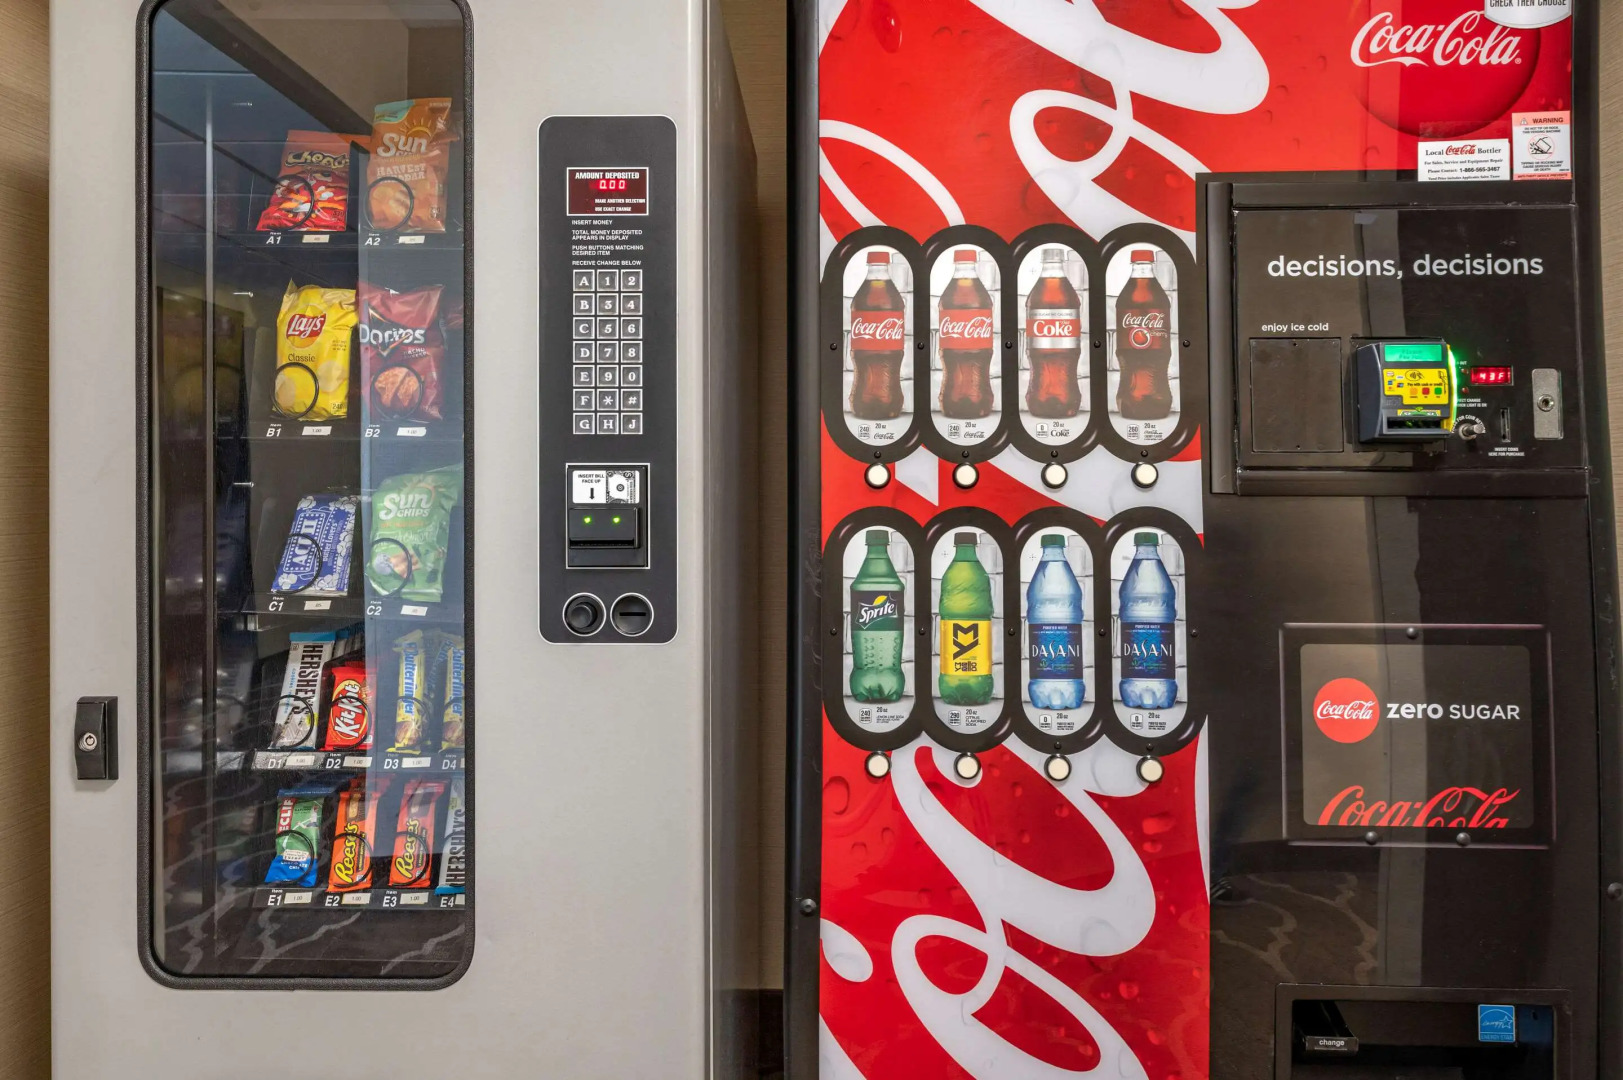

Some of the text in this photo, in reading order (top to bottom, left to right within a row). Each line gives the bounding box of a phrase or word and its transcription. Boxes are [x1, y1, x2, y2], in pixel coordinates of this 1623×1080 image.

[1351, 10, 1521, 67] Coca-Cola
[377, 133, 427, 157] Sun
[1445, 144, 1476, 156] Coca-Cola
[377, 163, 426, 177] HARVEST
[599, 180, 626, 189] 0.00
[266, 236, 281, 244] A1
[365, 237, 381, 246] A2
[1267, 253, 1544, 280] decisions, decisions
[579, 277, 589, 286] A
[605, 277, 610, 286] 1
[628, 277, 636, 286] 2
[580, 300, 589, 310] B
[604, 300, 612, 310] 3
[627, 300, 635, 310] 4
[288, 314, 326, 338] Lay's
[1122, 313, 1165, 329] Coca-Cola
[579, 324, 589, 333] C
[604, 324, 612, 333] 5
[628, 324, 636, 333] 6
[852, 317, 904, 340] Coca-Cola
[939, 316, 992, 339] Coca-Cola
[1033, 320, 1073, 337] Coke
[1261, 322, 1329, 333] enjoy ice cold
[360, 324, 426, 345] Doritos
[288, 353, 316, 362] Classic
[580, 348, 590, 358] D
[604, 348, 612, 358] 7
[628, 348, 636, 358] 8
[580, 372, 589, 381] E
[604, 372, 612, 381] 9
[628, 372, 636, 381] 0
[580, 396, 590, 405] F
[579, 420, 590, 429] G
[603, 420, 613, 429] H
[628, 420, 636, 429] J
[266, 428, 281, 437] B1
[365, 429, 381, 438] B2
[1050, 429, 1070, 437] Coke
[379, 493, 431, 520] Sun
[397, 508, 430, 517] CHIPS
[268, 601, 284, 611] C1
[366, 605, 382, 616] C2
[858, 603, 895, 623] Sprite
[1032, 641, 1080, 659] DASANI
[1124, 639, 1172, 659] DASANI
[403, 641, 418, 716] Butterfiner
[1317, 700, 1520, 720] Coca-Cola zero SUGAR
[268, 759, 282, 769] D1
[326, 759, 341, 769] D2
[384, 759, 399, 769] D3
[442, 759, 457, 770] D4
[335, 822, 359, 883] Rees's
[267, 894, 282, 906] E1
[325, 896, 340, 907] E2
[382, 896, 397, 907] E3
[440, 897, 455, 907] E4
[1319, 1039, 1345, 1048] change
